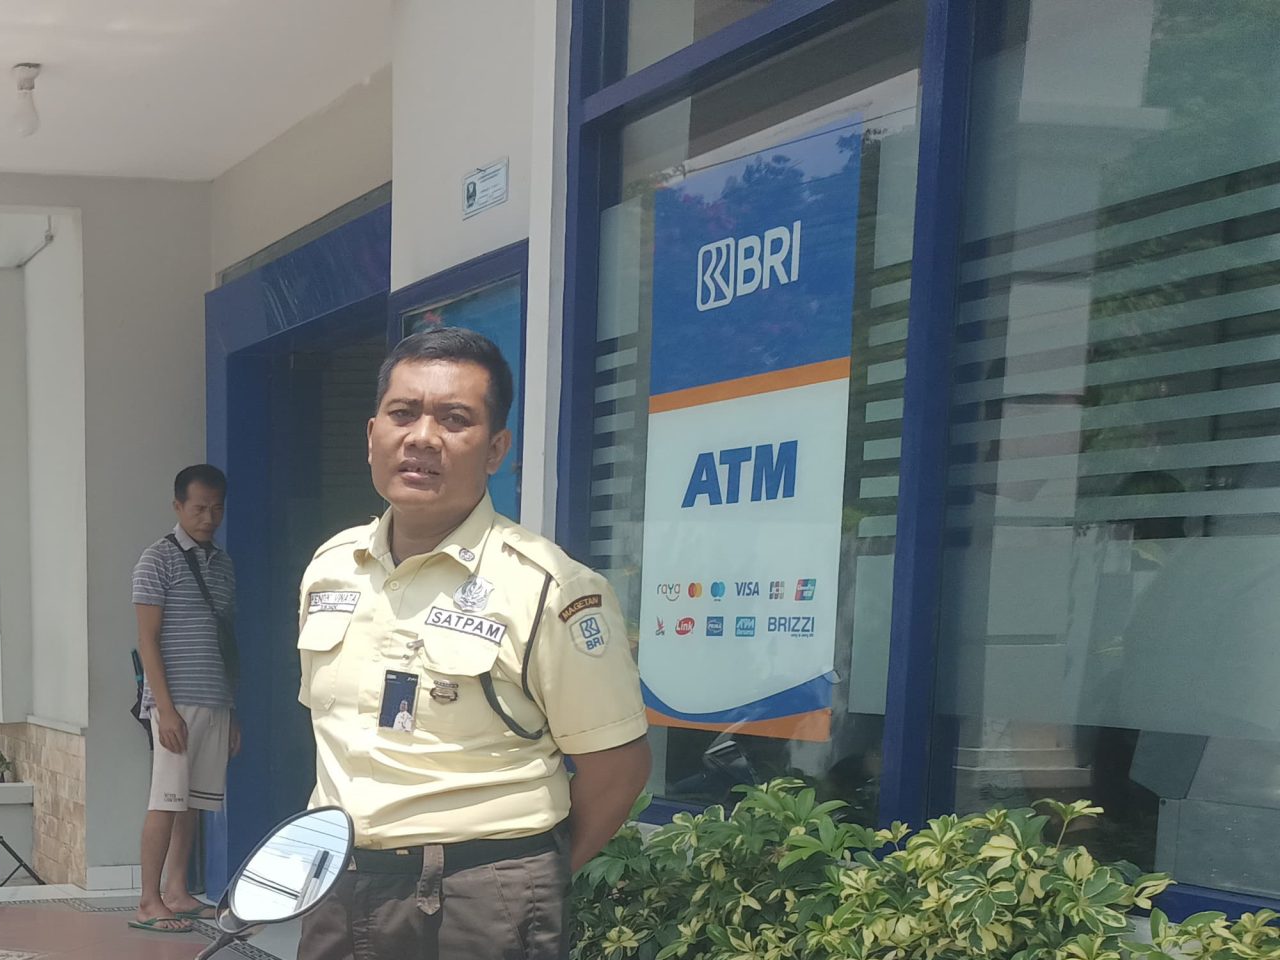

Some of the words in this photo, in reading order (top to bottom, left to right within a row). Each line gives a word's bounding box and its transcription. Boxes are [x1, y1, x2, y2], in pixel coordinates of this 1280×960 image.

[737, 220, 801, 297] BRI
[681, 440, 798, 508] ATM
[735, 581, 760, 597] VISA
[561, 596, 599, 620] MAGETAN
[431, 611, 501, 639] SATPAM
[767, 616, 815, 633] BRIZZI
[585, 635, 605, 650] BRI
